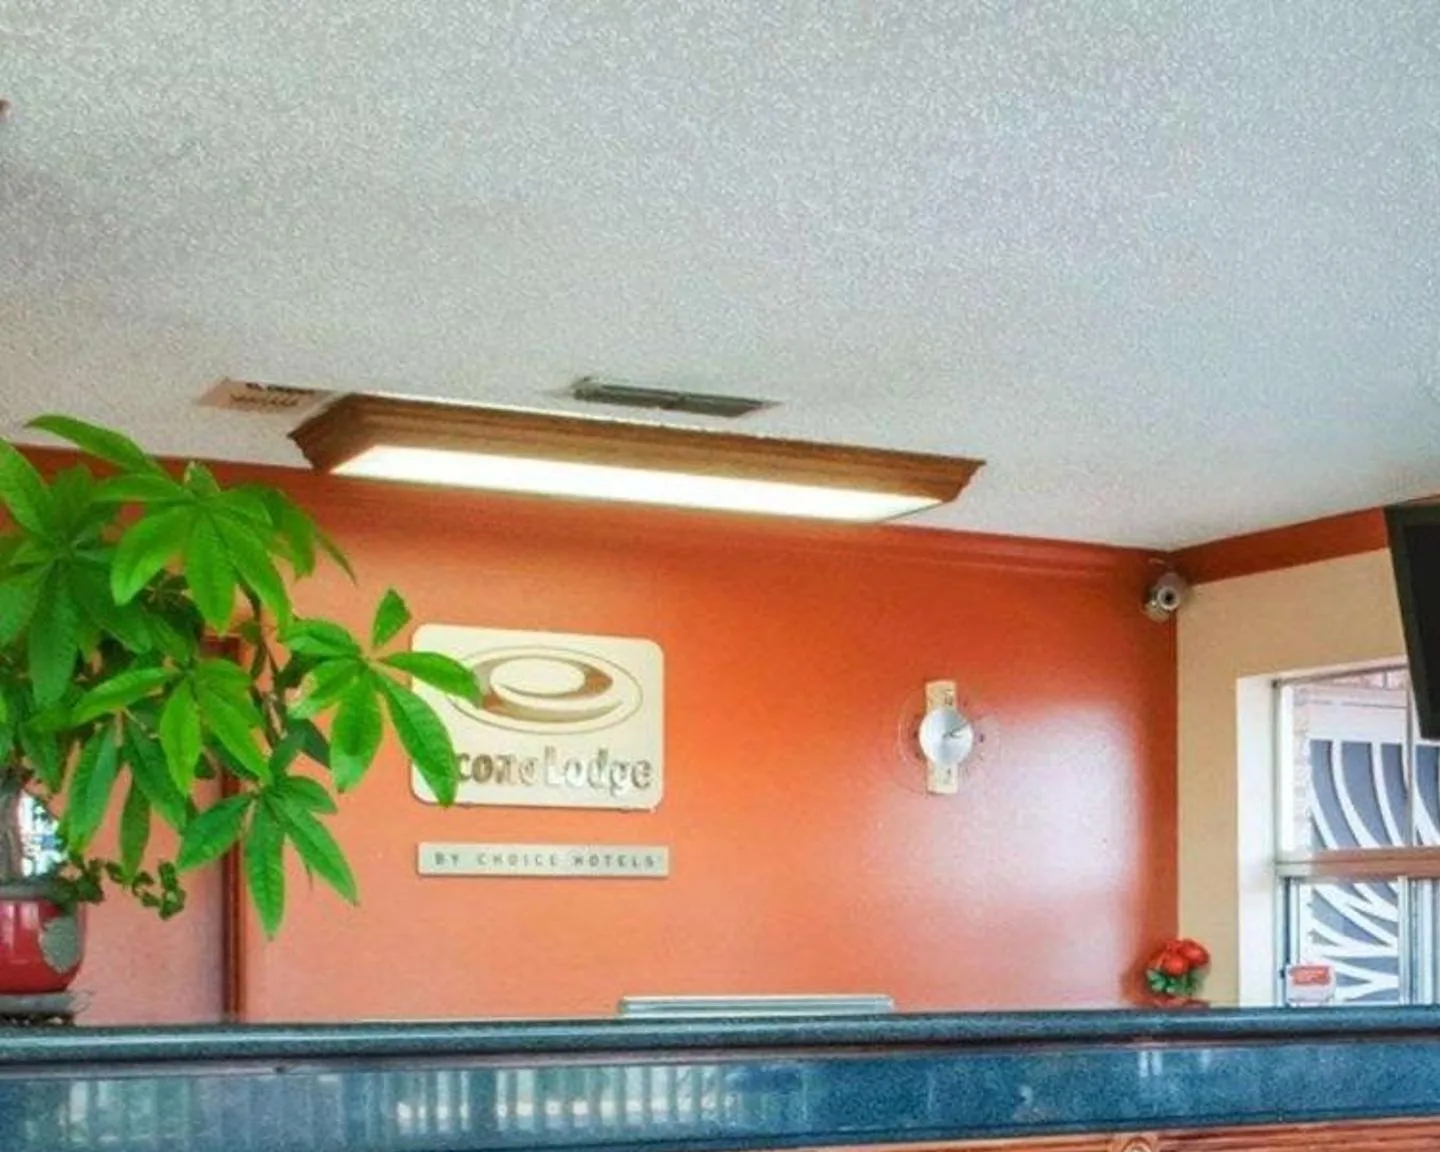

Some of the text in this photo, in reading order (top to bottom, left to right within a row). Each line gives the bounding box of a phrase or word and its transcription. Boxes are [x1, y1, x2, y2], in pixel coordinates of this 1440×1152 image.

[456, 745, 653, 798] conoLodge
[434, 852, 656, 869] BY CHOICE HOTELS
